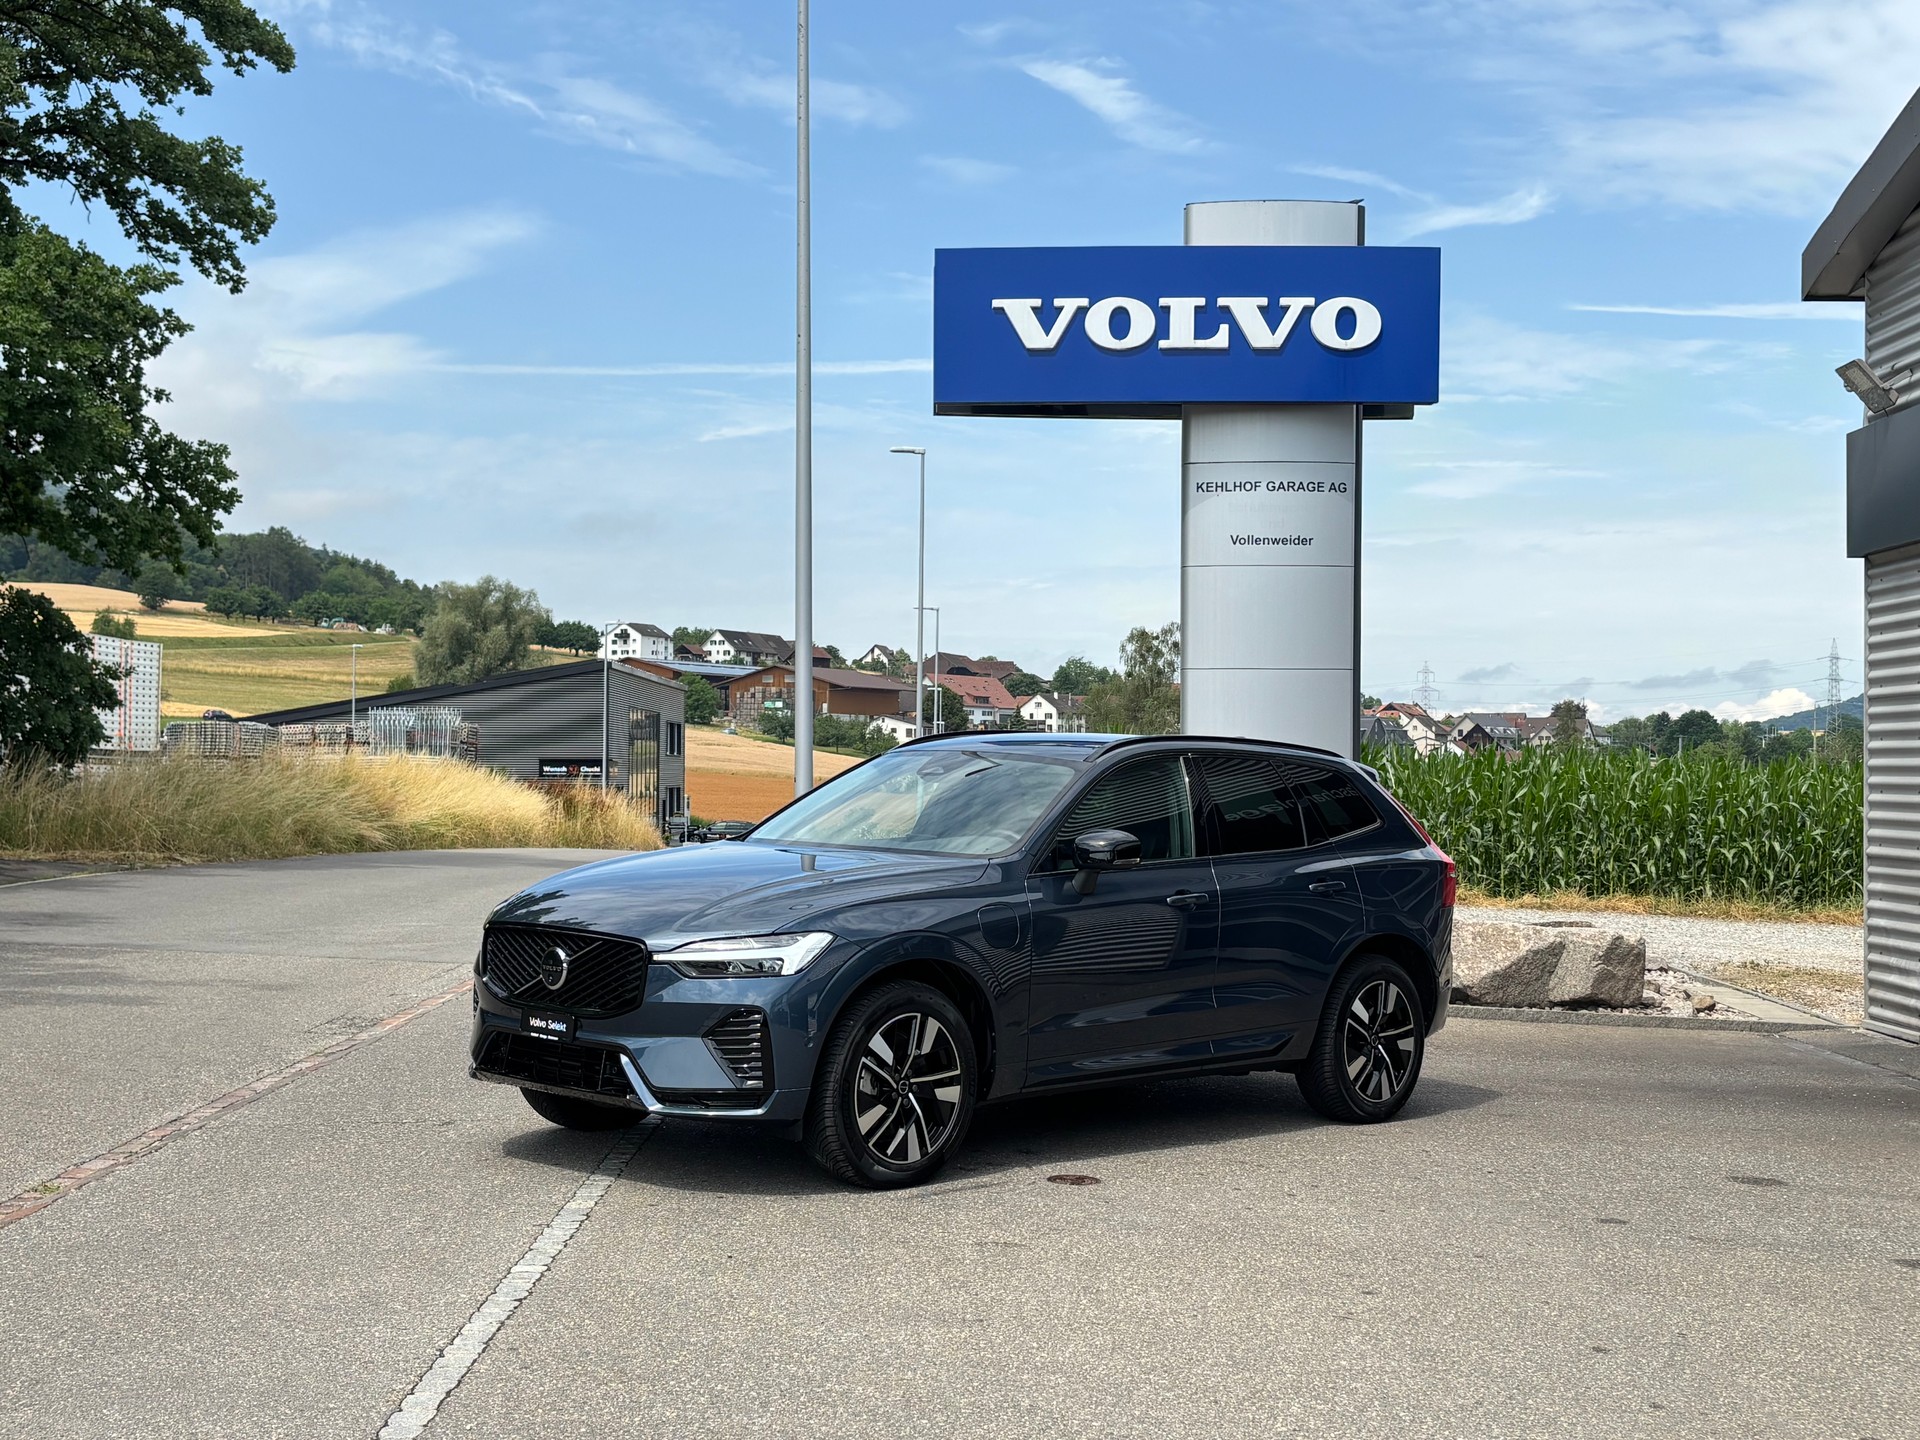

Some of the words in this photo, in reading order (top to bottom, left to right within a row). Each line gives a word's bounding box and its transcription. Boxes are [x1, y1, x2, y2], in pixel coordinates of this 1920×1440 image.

[991, 296, 1382, 351] VOLVO
[1196, 481, 1262, 493] KEHLHOF
[1266, 481, 1325, 493] GARAGE
[1328, 482, 1348, 493] AG
[1230, 534, 1314, 546] Vollenweider
[542, 964, 562, 972] VOLVO
[529, 1016, 547, 1028] Volvo
[547, 1019, 567, 1032] Selekt
